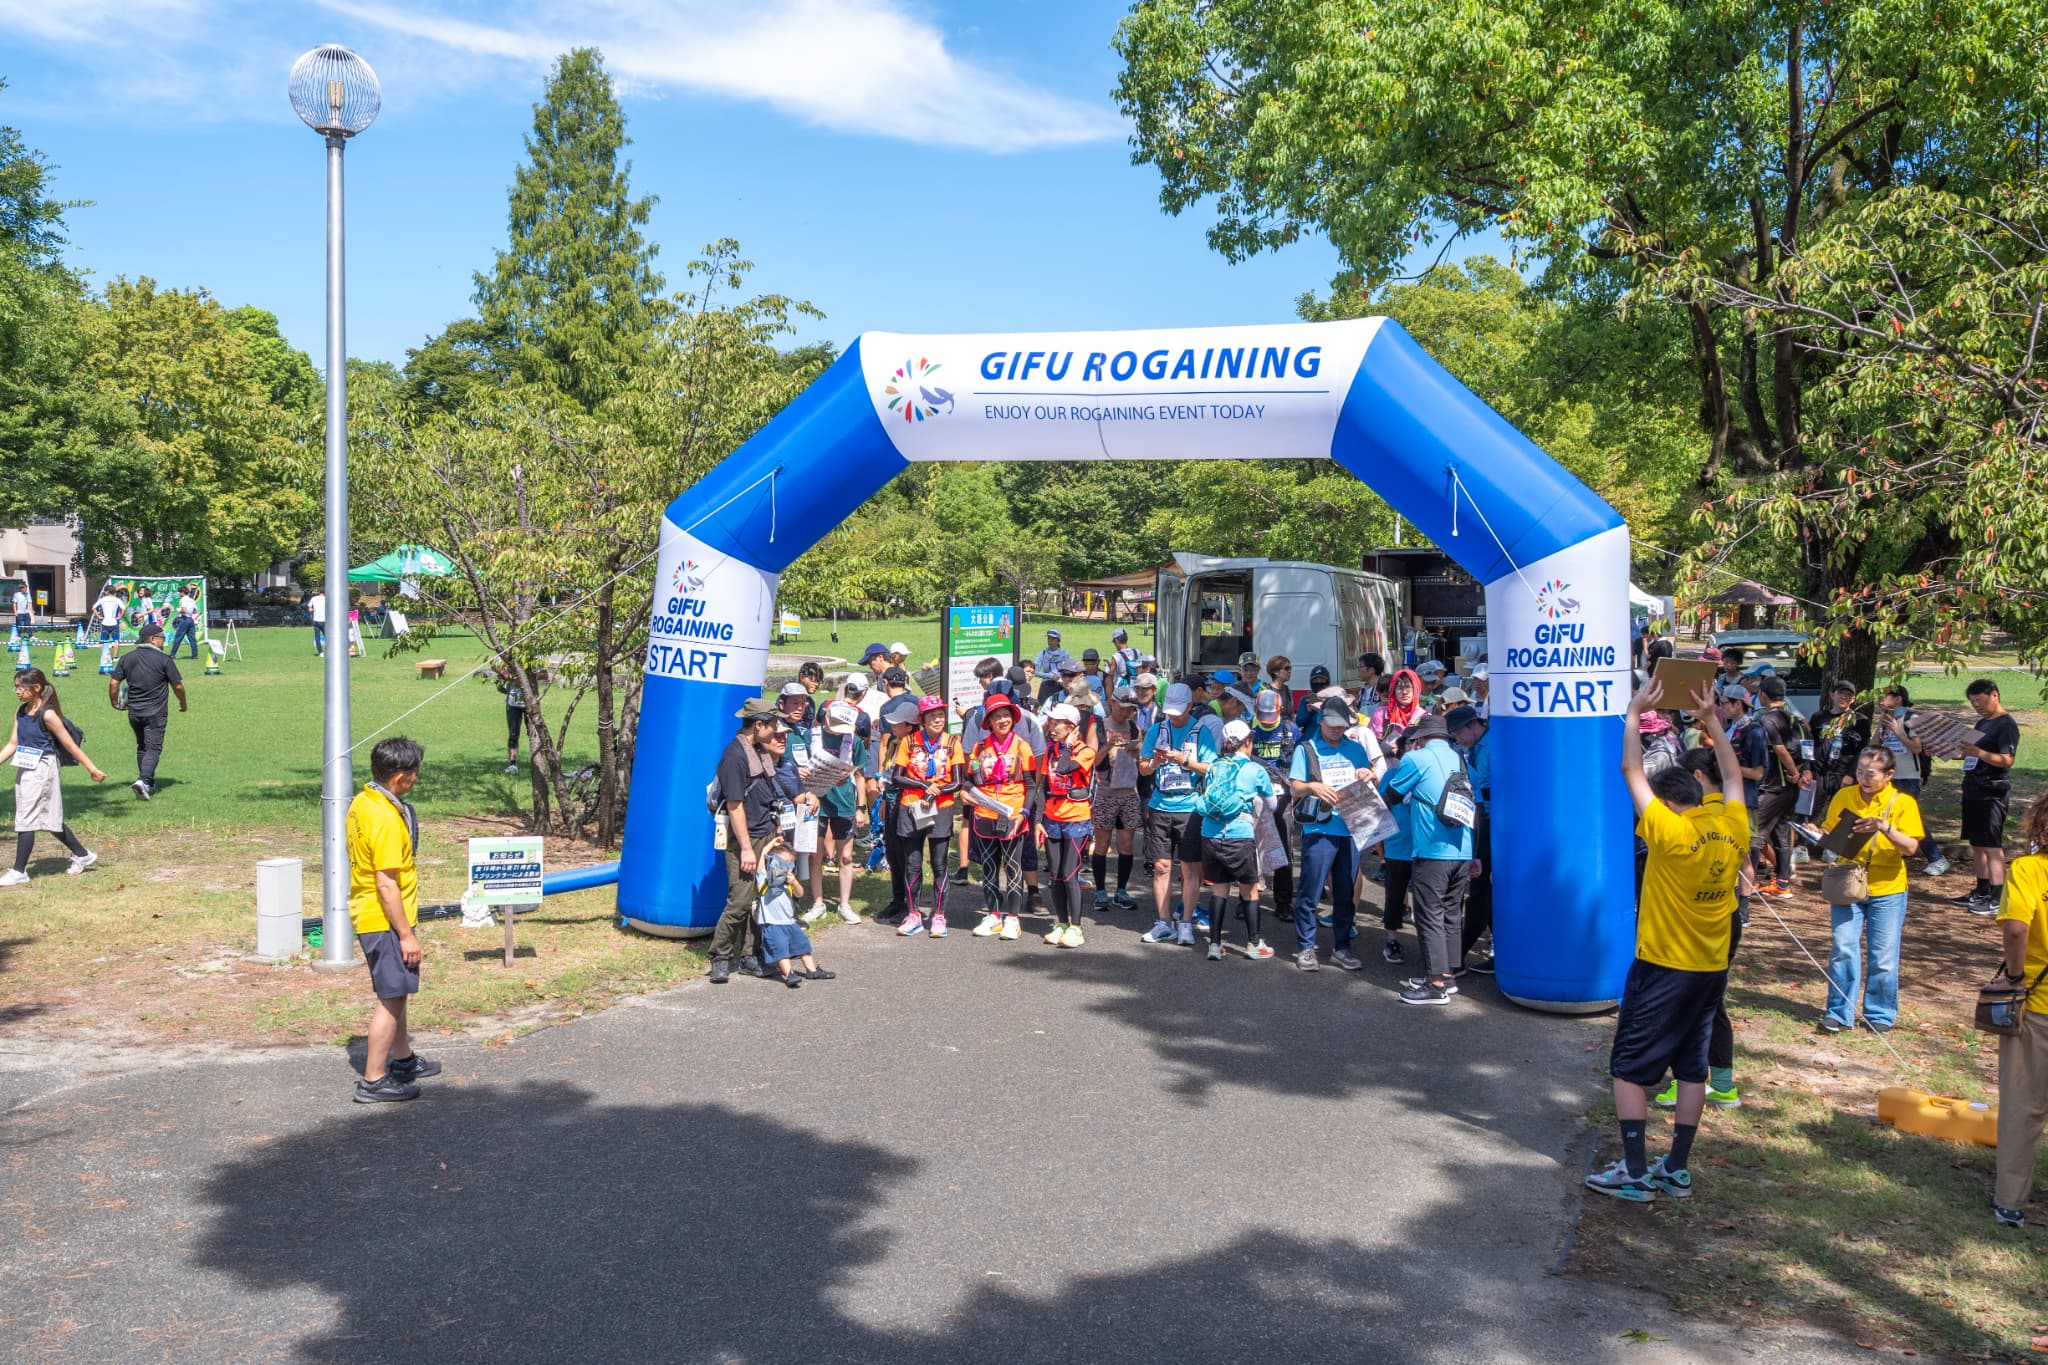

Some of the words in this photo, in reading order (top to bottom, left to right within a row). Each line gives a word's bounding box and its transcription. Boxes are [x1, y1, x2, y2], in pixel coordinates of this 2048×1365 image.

[980, 351, 1074, 382] GIFU
[1082, 346, 1322, 382] ROGAINING
[985, 405, 1032, 420] ENJOY
[1034, 405, 1067, 421] OUR
[1070, 405, 1155, 422] ROGAINING
[1160, 405, 1208, 420] EVENT
[1210, 404, 1266, 420] TODAY
[668, 597, 706, 617] GIFU
[652, 616, 734, 640] ROGAINING
[1534, 623, 1585, 645] GIFU
[649, 644, 728, 679] START
[1507, 646, 1615, 668] ROGAINING
[1512, 680, 1613, 713] START
[1694, 890, 1727, 901] STAFF
